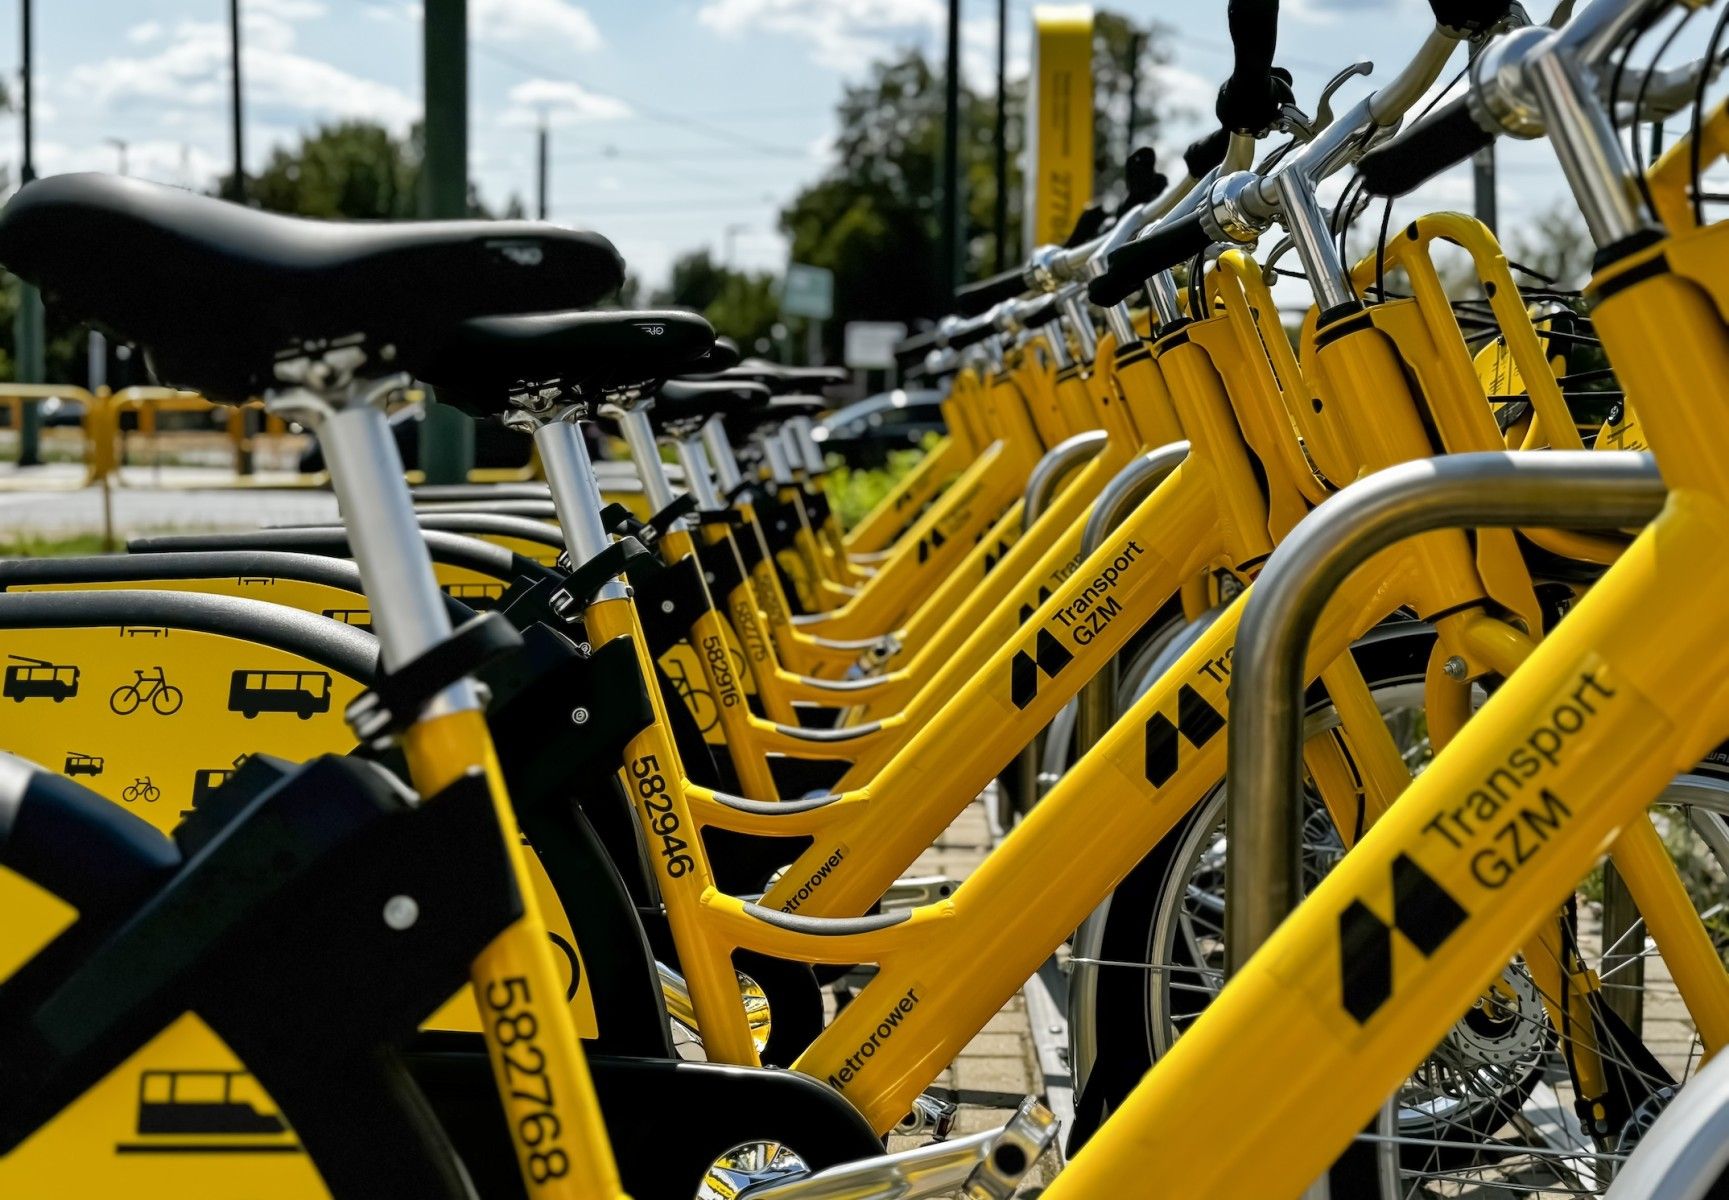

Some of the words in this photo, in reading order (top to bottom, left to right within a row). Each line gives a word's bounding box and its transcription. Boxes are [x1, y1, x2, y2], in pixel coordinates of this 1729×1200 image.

[1052, 540, 1144, 628] Transport
[1073, 595, 1123, 646] GZM
[703, 635, 740, 708] 582916
[1421, 672, 1615, 849] Transport
[632, 754, 695, 879] 582946
[1471, 787, 1573, 890] GZM
[781, 848, 844, 914] etrorower
[487, 976, 570, 1185] 582768
